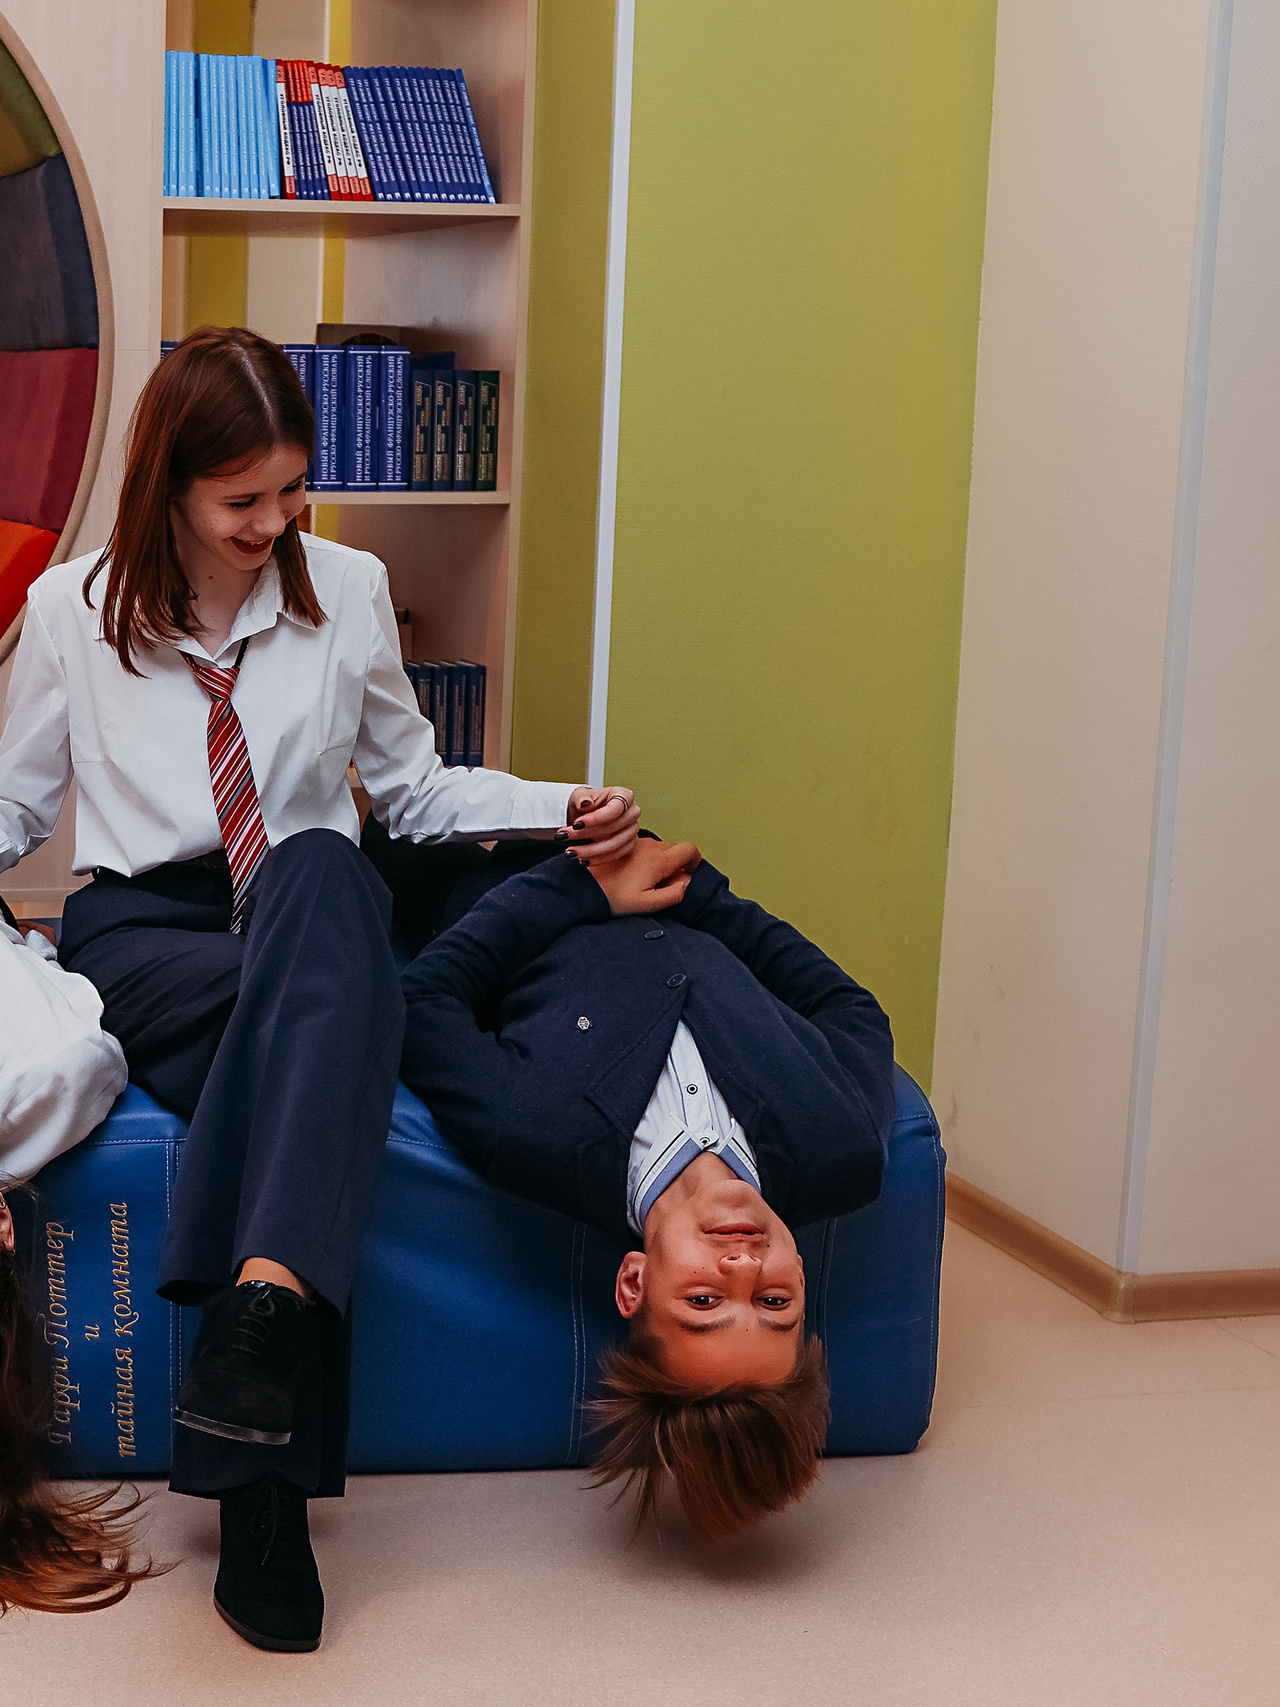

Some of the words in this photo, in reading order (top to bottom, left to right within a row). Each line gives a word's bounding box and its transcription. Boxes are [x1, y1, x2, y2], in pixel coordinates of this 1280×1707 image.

[356, 450, 364, 481] НОВЫЙ
[387, 450, 395, 481] НОВЫЙ
[36, 1221, 74, 1349] Поттер
[84, 1324, 101, 1342] и
[47, 1355, 81, 1445] Гарри
[110, 1347, 136, 1458] тайная
